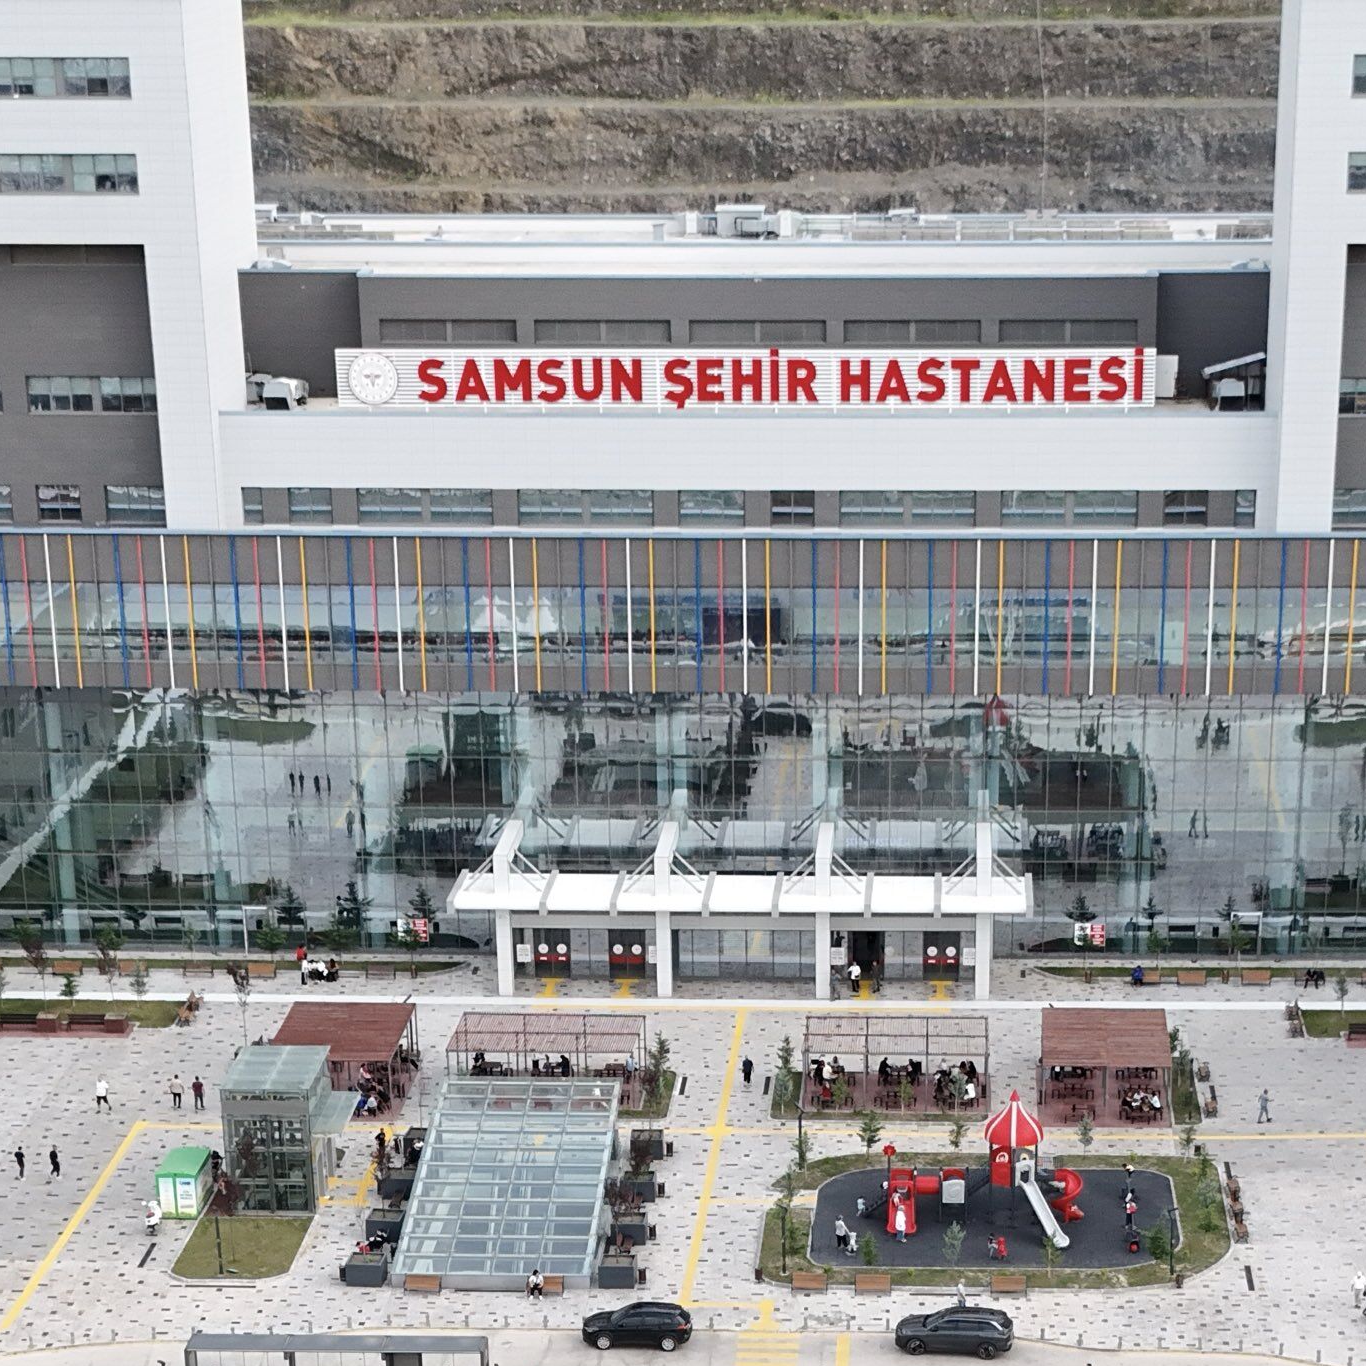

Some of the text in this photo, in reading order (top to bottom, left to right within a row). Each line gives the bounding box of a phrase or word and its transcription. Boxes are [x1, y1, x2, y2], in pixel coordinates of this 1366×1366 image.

[418, 347, 1144, 409] SAMSUN ŞEHİR HASTANESİ
